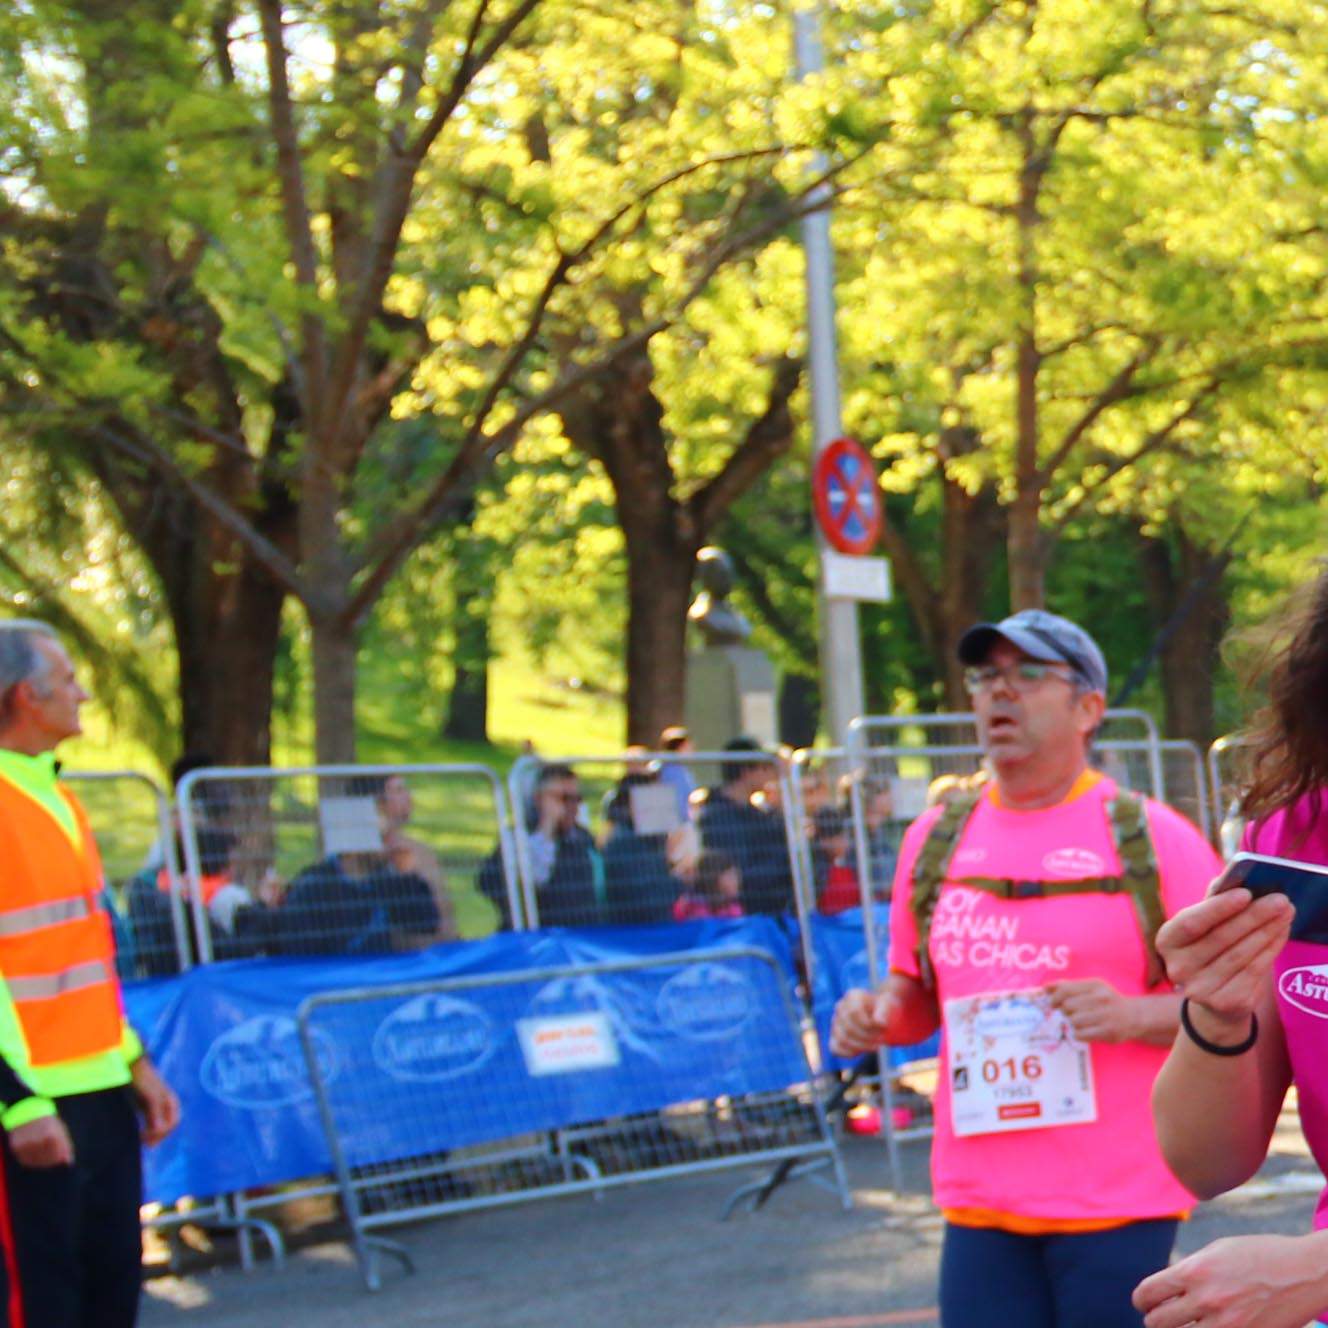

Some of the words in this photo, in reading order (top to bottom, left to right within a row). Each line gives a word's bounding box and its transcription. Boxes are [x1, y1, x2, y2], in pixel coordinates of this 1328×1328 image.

[940, 887, 985, 914] OY
[936, 940, 964, 967] AS
[968, 941, 1071, 972] CHICAS
[982, 1054, 1043, 1084] 016
